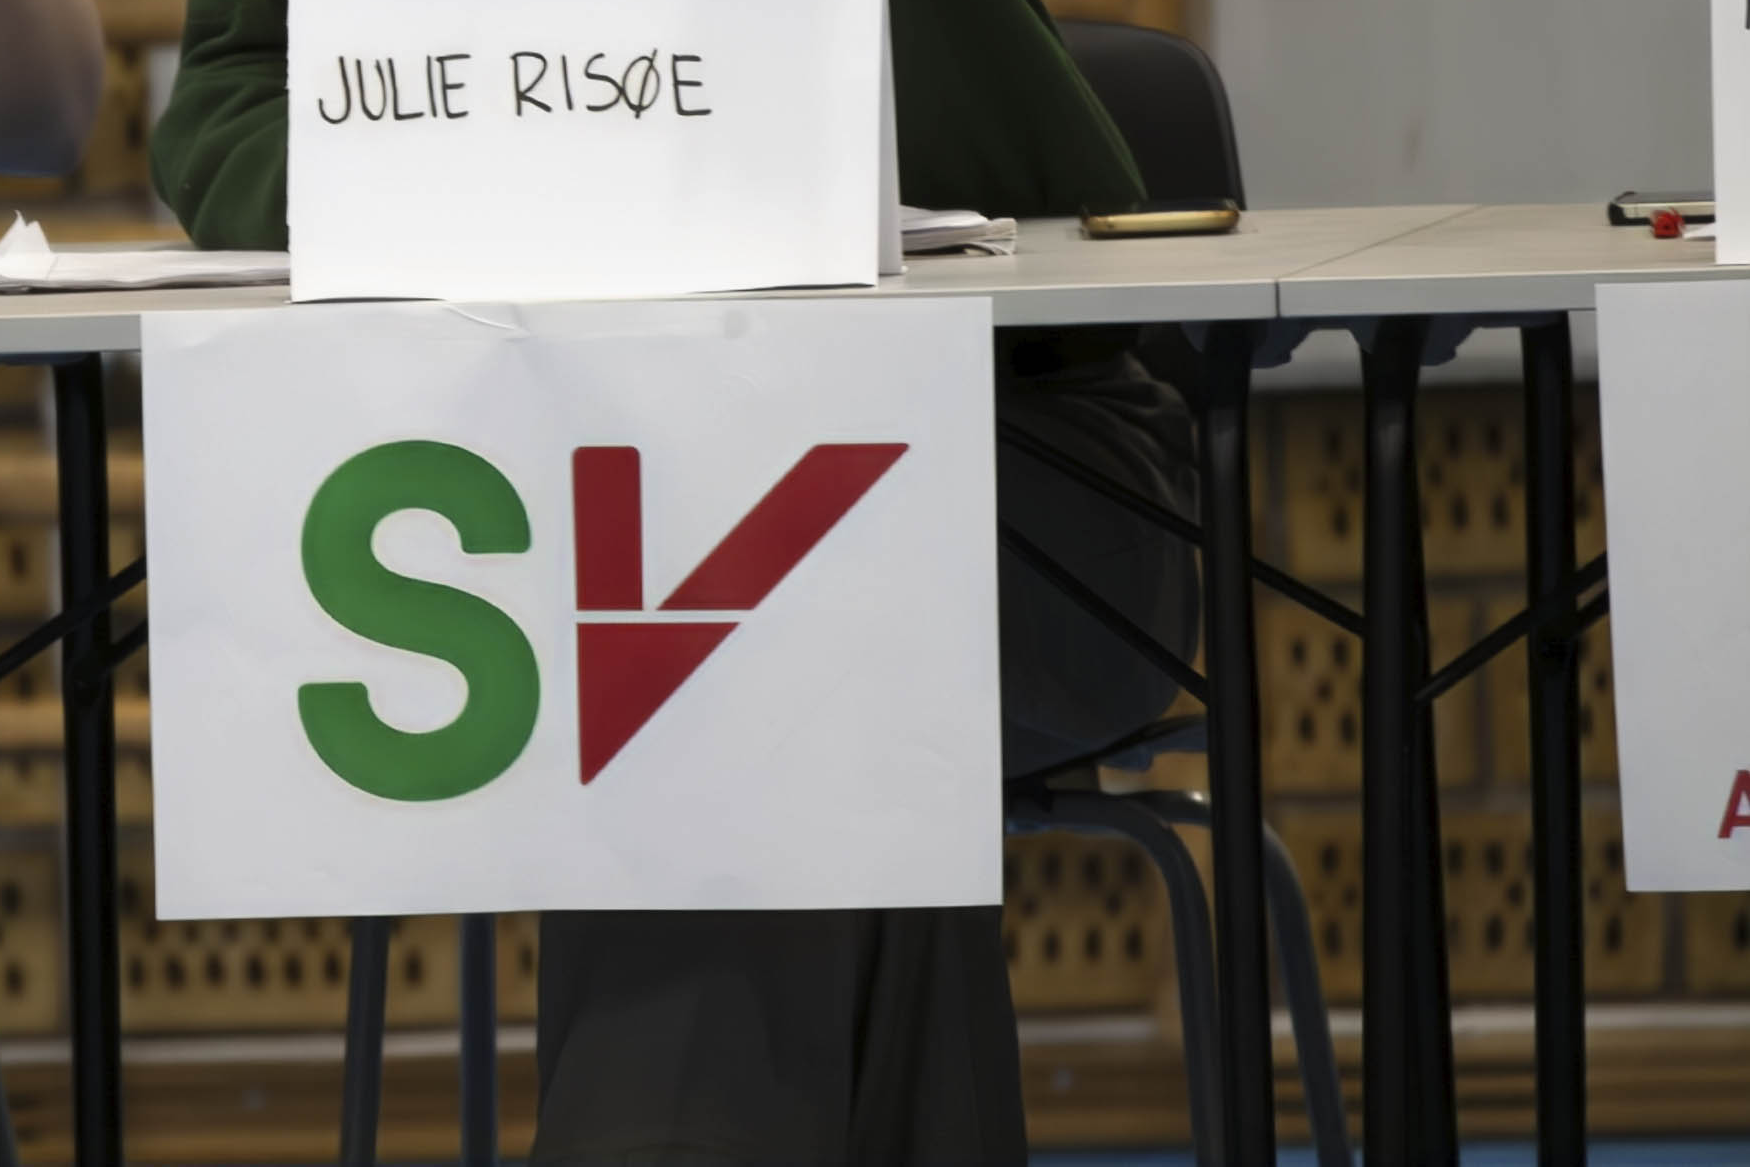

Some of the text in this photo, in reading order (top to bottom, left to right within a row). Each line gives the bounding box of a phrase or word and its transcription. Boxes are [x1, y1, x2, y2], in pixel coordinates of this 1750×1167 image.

[317, 48, 713, 125] JULIE RISØE
[297, 439, 910, 803] SV
